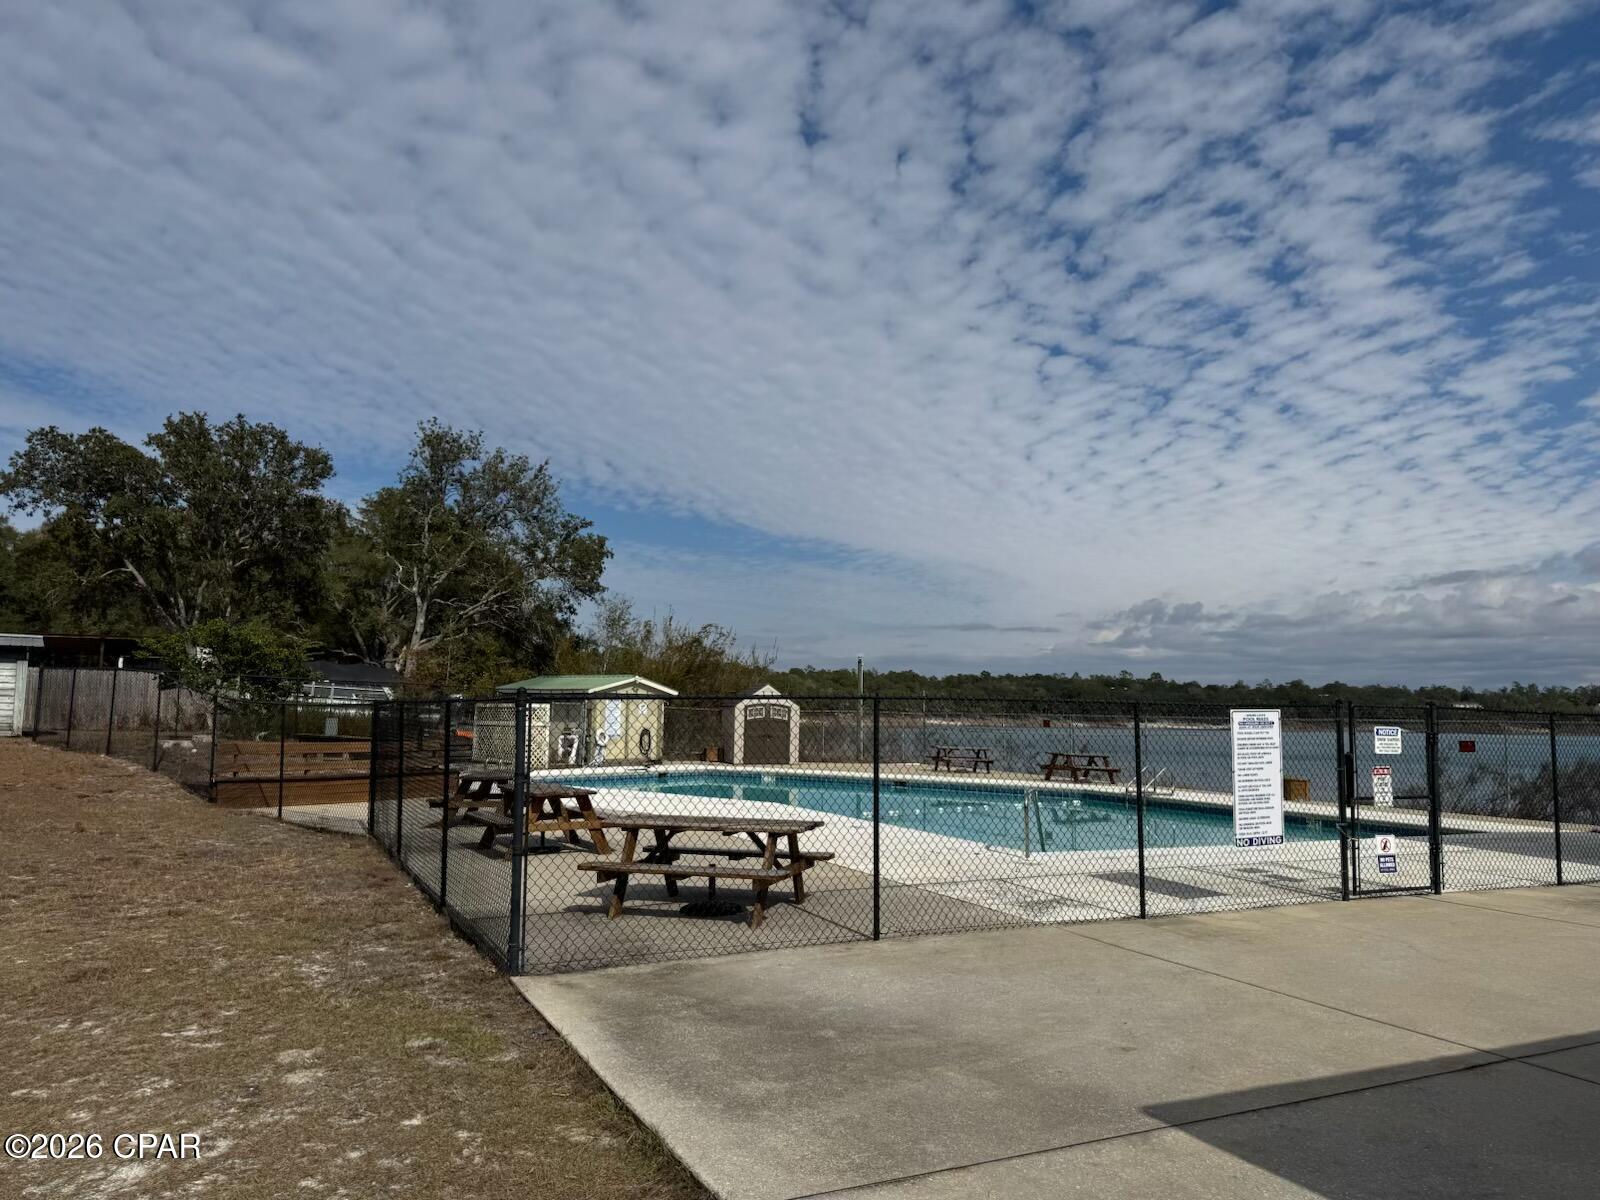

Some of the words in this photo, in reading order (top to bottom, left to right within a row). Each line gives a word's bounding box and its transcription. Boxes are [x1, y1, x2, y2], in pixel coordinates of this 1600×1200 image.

[1378, 728, 1399, 736] NOTICE
[1237, 838, 1250, 847] NO
[1252, 836, 1282, 846] DIVING
